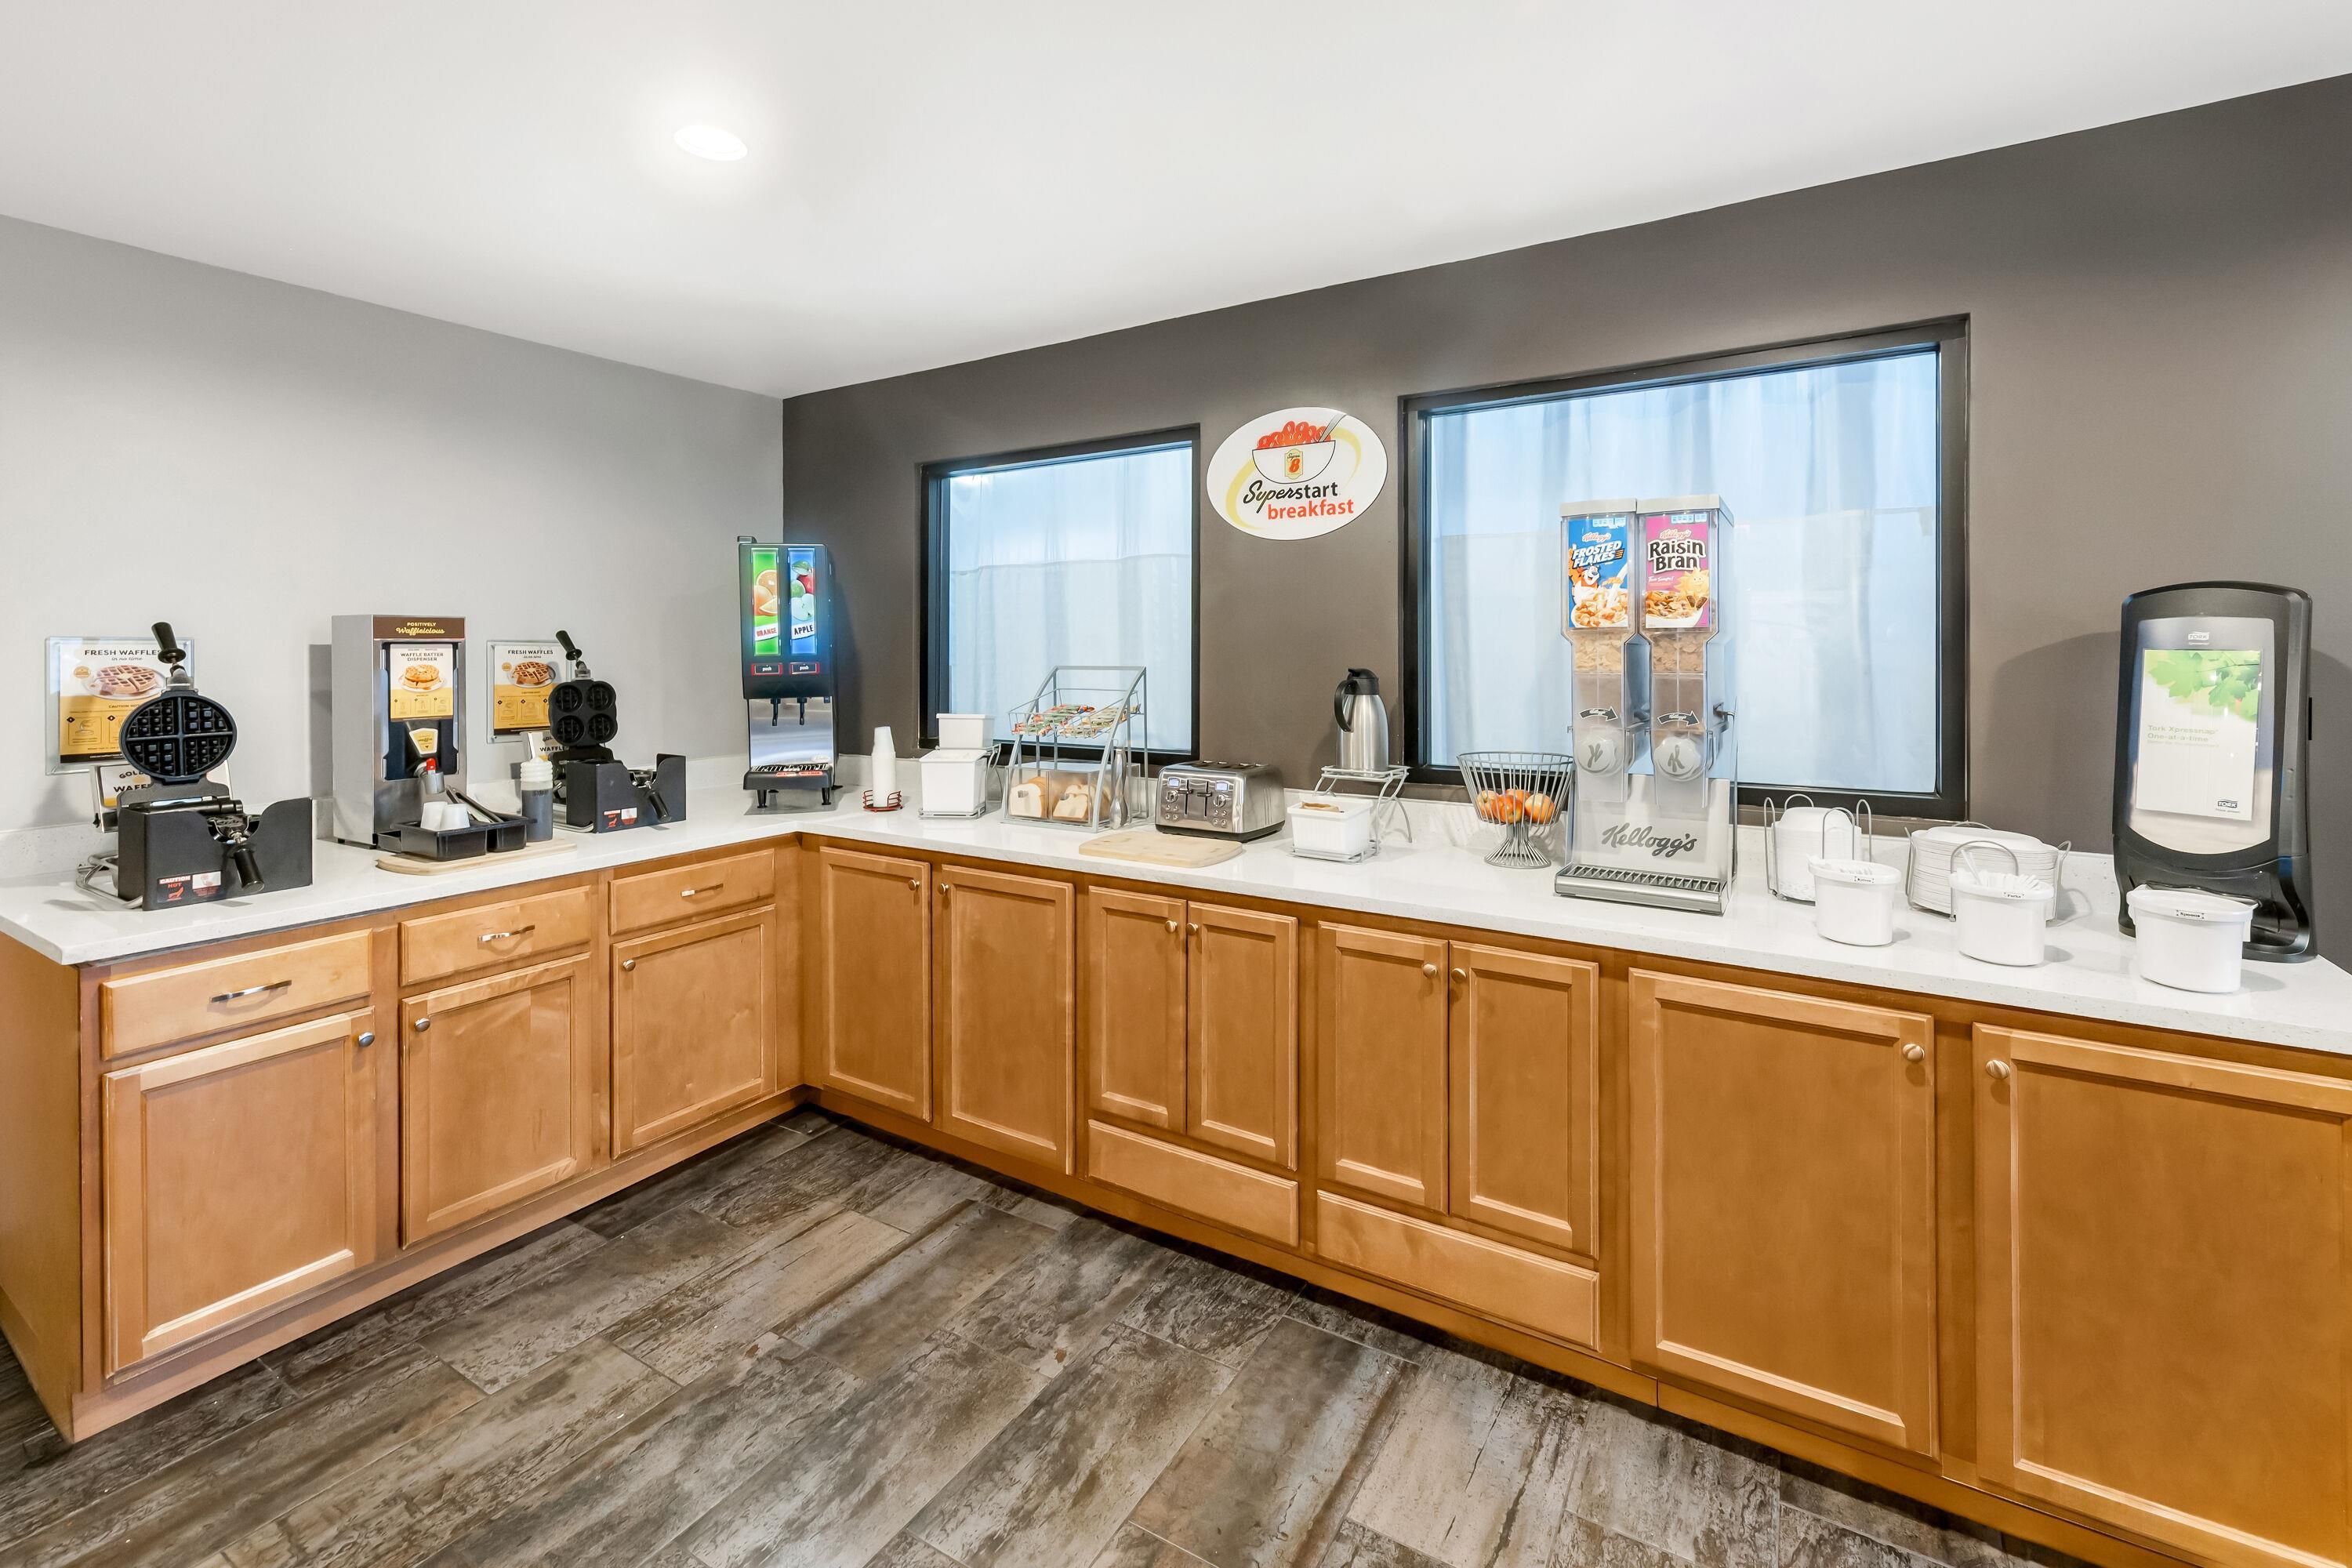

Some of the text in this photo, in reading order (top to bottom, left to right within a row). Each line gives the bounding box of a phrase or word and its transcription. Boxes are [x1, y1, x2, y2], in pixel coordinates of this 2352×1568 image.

[1288, 458, 1301, 474] 8
[1243, 479, 1338, 514] Superstart
[1268, 499, 1354, 521] breakfast
[1660, 529, 1692, 540] Kellogg's
[1572, 540, 1622, 560] FROSTED
[1649, 540, 1704, 558] Raisin
[1573, 550, 1615, 568] FLAKES
[1655, 555, 1698, 572] Bran
[756, 627, 778, 637] ORANGE
[793, 624, 815, 636] APPLE
[1601, 822, 1697, 858] Kellogg's
[159, 875, 191, 884] CAUTION
